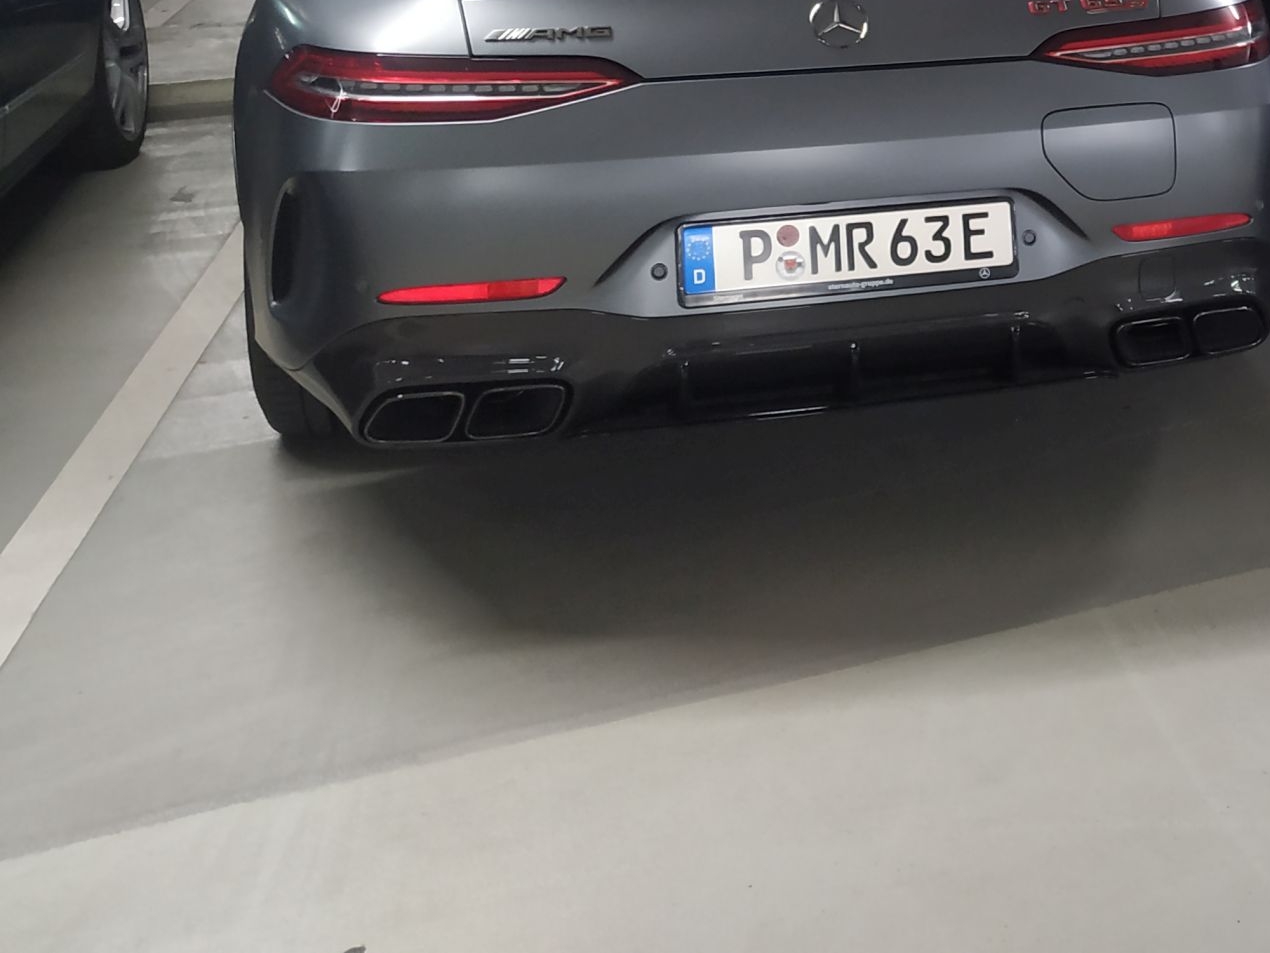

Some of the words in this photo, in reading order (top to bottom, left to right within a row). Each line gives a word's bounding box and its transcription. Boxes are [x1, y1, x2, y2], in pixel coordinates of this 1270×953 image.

[529, 26, 613, 41] AMG
[738, 229, 773, 282] P
[808, 220, 879, 276] MR
[889, 211, 995, 267] 63E
[693, 269, 706, 285] D
